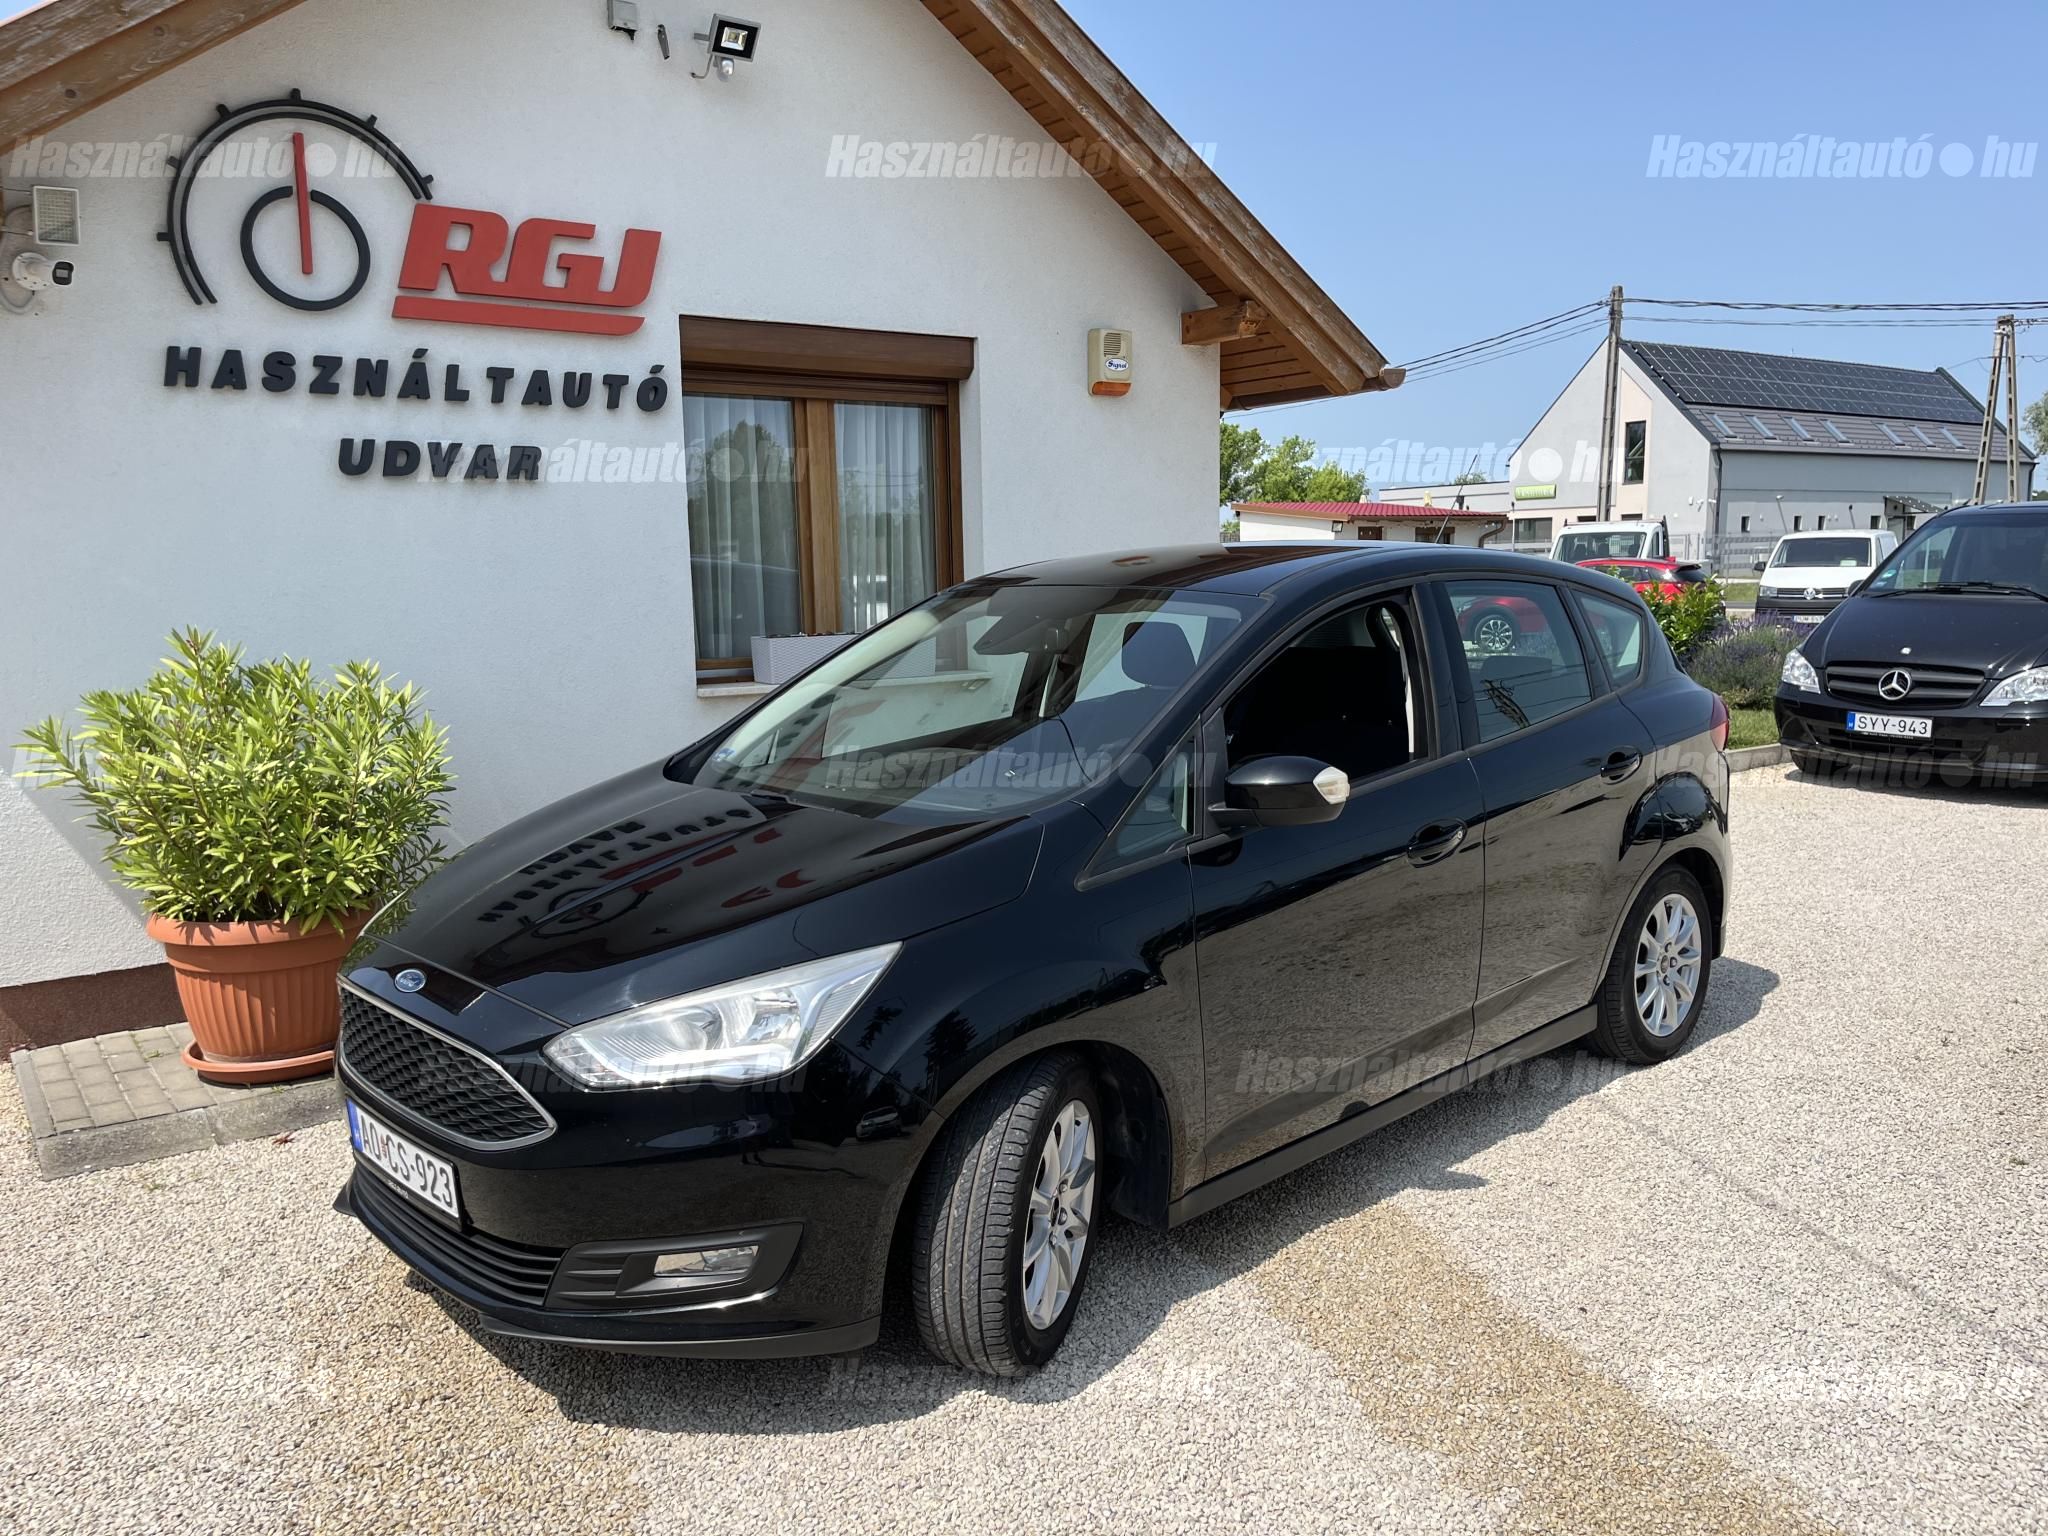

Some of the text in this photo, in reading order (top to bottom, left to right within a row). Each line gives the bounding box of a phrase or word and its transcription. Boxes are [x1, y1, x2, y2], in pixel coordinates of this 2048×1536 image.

[397, 203, 662, 308] RGJ
[164, 345, 668, 412] HASZNÁLTAUTÓ
[338, 438, 543, 481] UDVAR
[1857, 715, 1928, 735] SYY-943
[385, 1133, 453, 1209] CS-923
